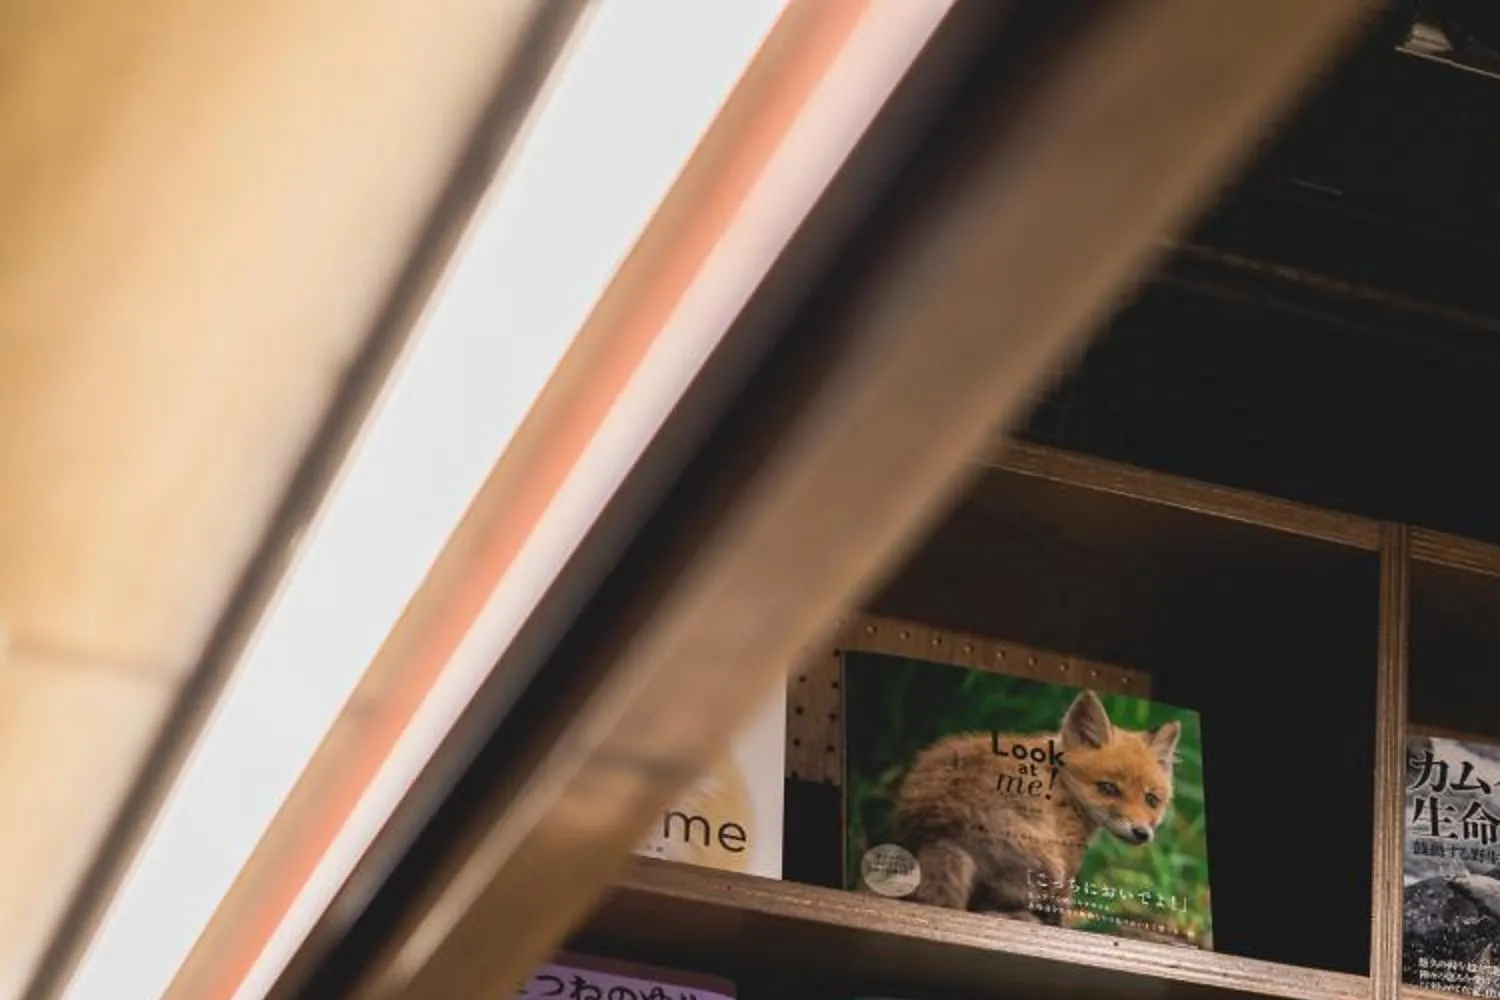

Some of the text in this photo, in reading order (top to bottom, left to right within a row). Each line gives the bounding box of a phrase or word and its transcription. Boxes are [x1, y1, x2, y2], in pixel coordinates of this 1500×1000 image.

[990, 730, 1066, 767] Look
[996, 766, 1059, 800] me!
[1016, 763, 1037, 776] at
